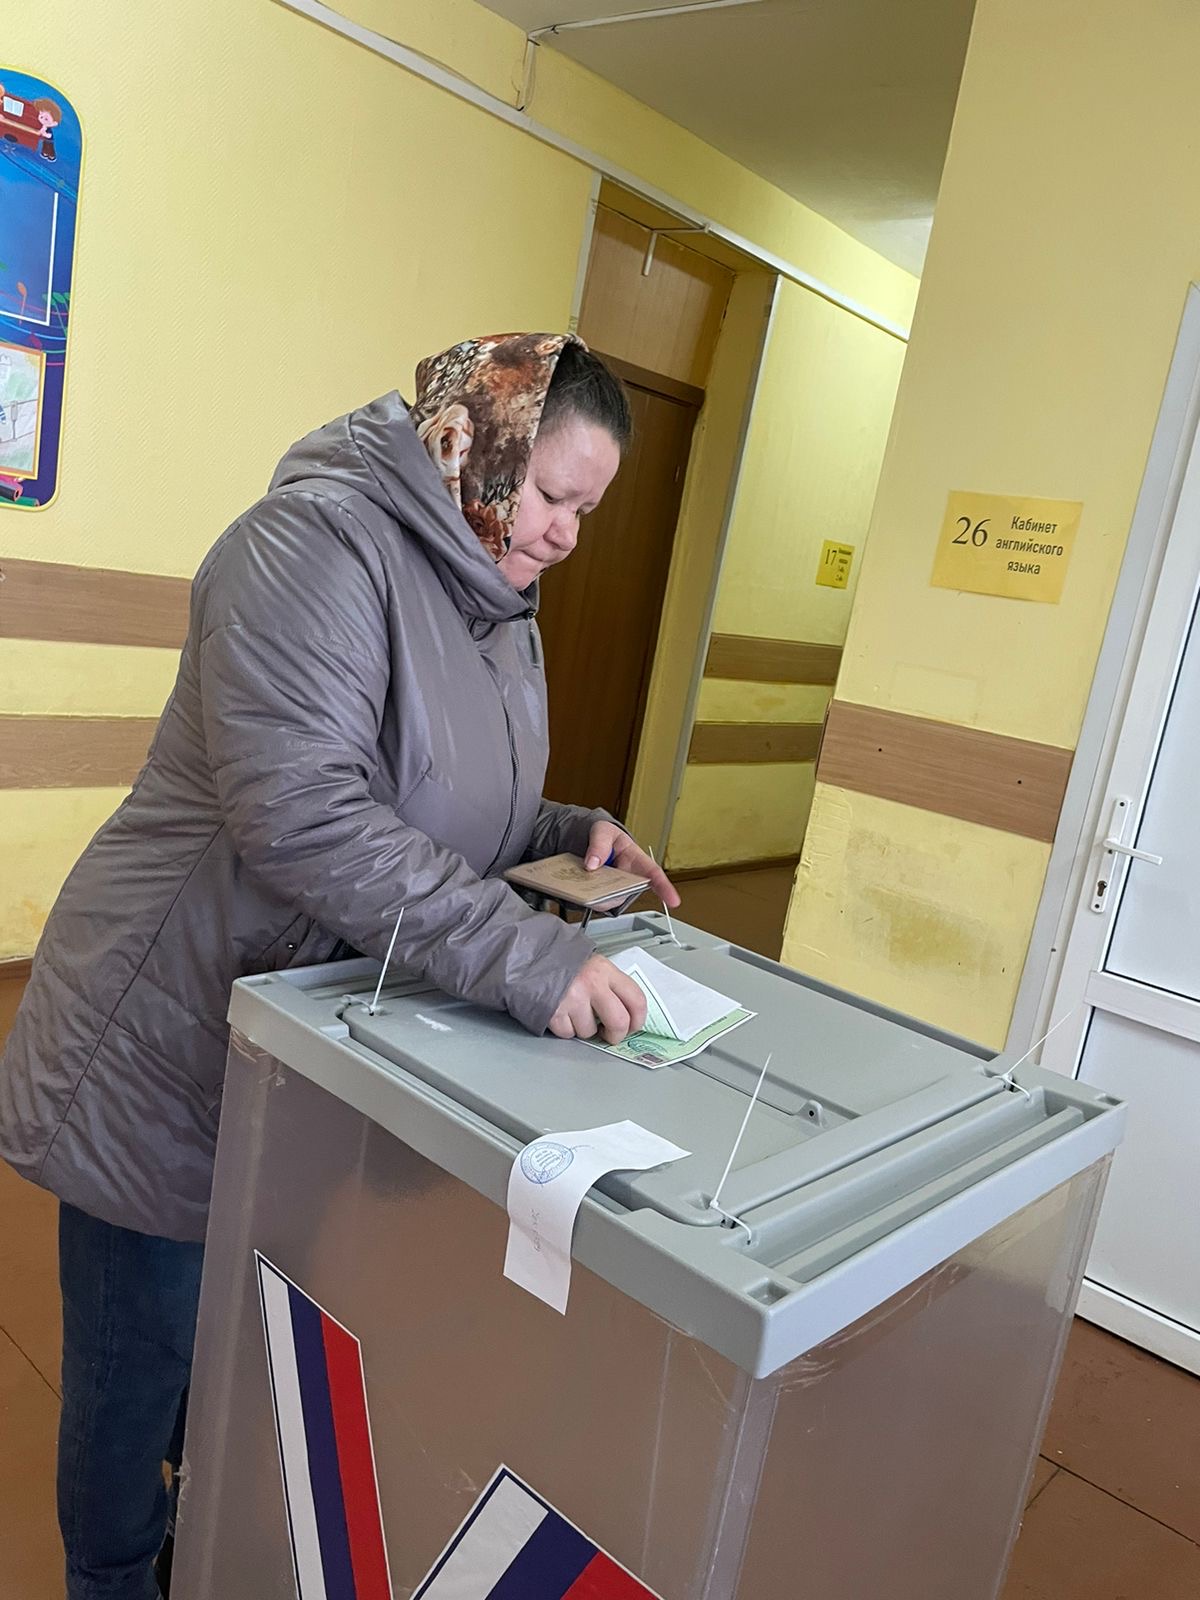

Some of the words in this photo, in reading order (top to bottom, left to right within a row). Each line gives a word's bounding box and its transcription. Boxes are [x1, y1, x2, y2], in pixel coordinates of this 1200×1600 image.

[952, 516, 991, 547] 26
[1011, 516, 1057, 534] Кабинет
[995, 538, 1063, 556] английского
[825, 549, 837, 565] 17
[1007, 561, 1040, 574] языка
